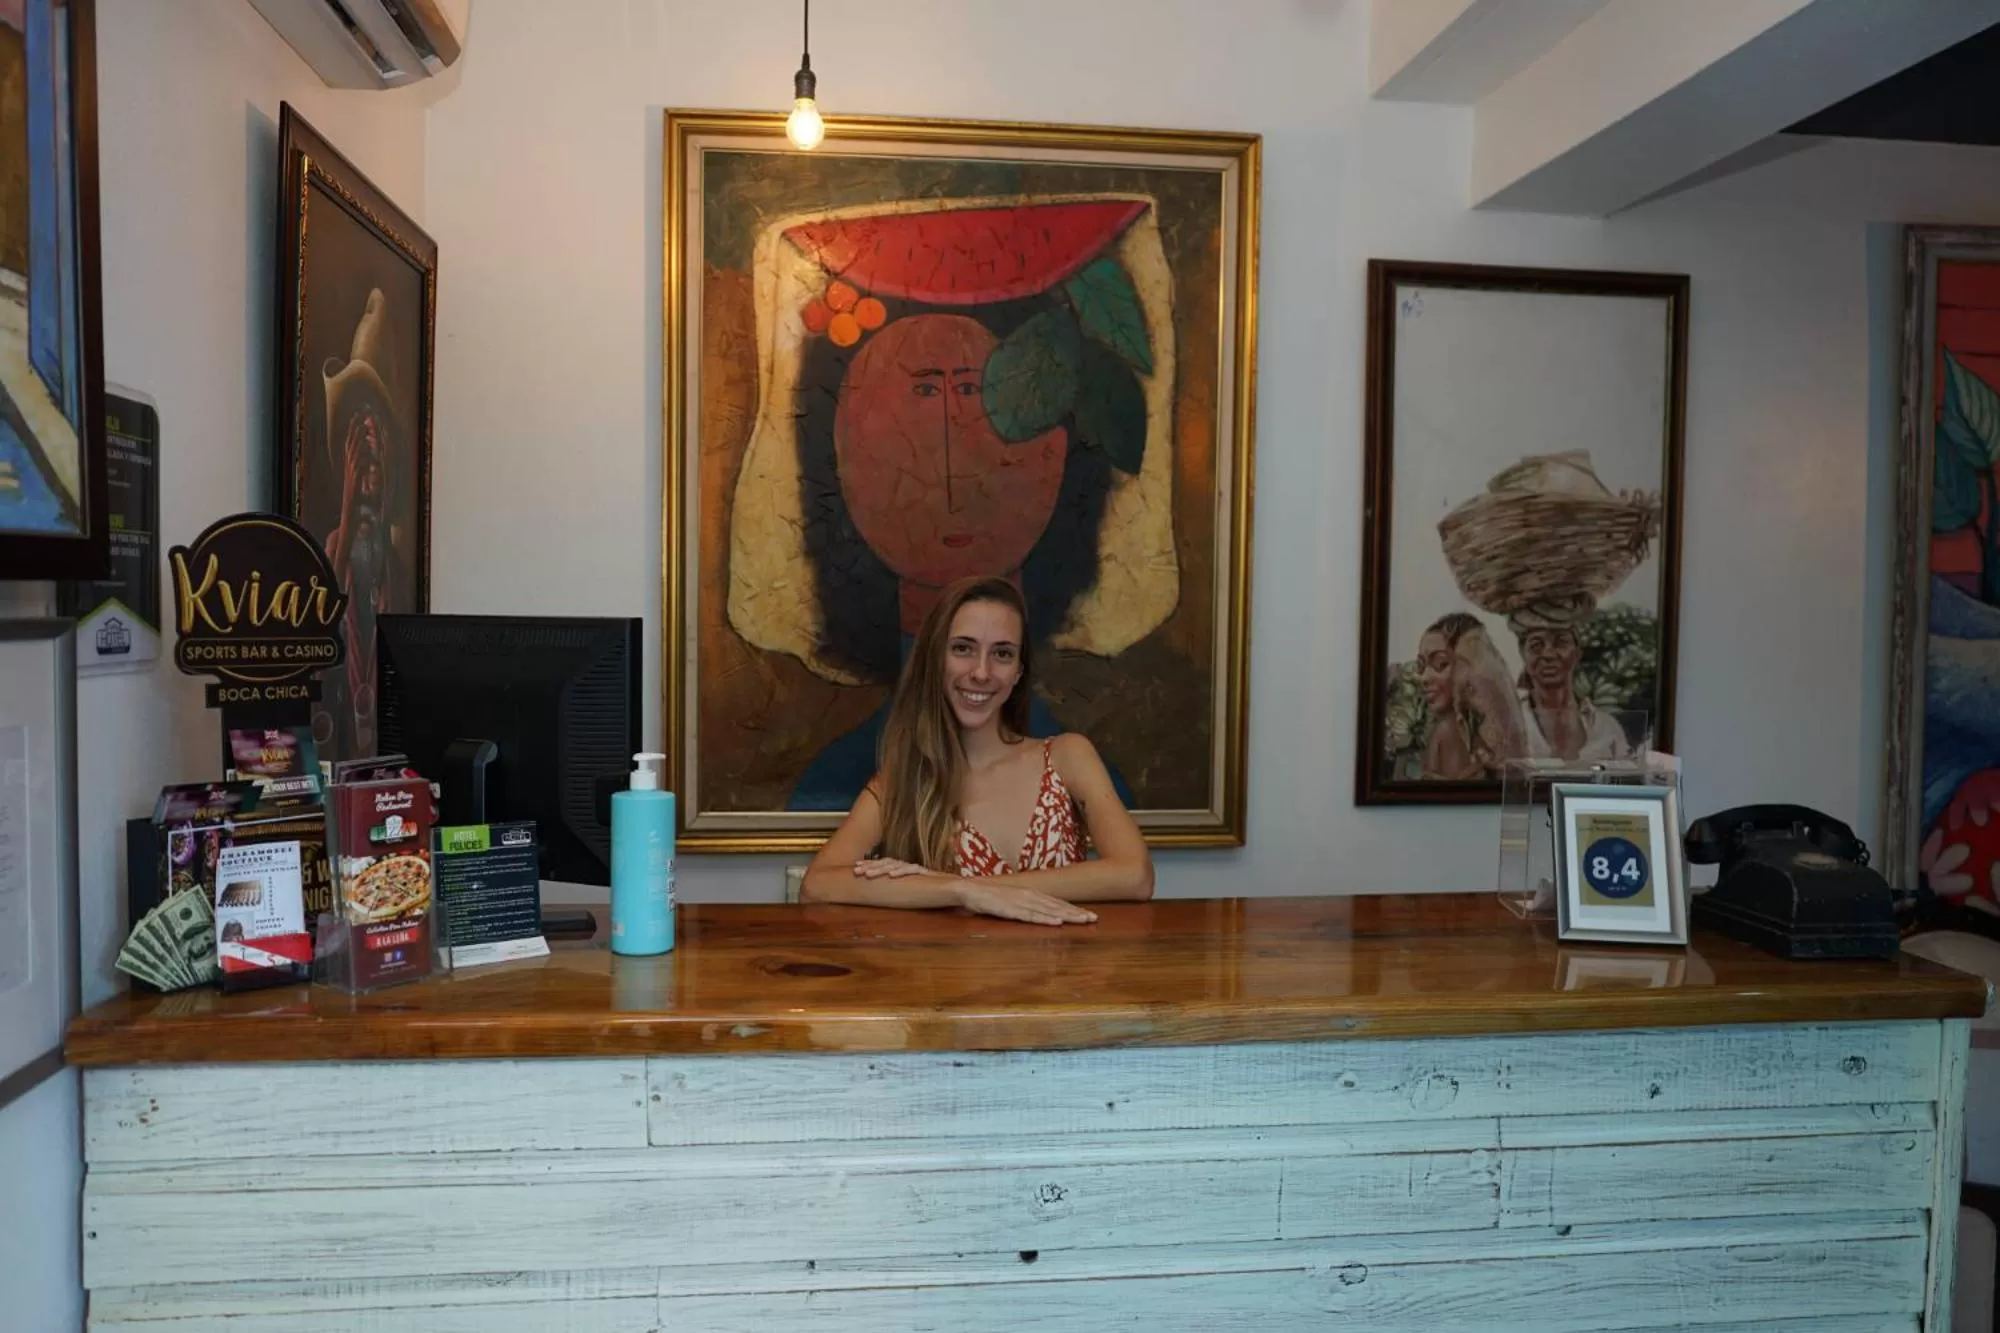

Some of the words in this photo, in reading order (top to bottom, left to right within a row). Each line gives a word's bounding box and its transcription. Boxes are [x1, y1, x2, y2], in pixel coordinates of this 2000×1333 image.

[174, 551, 341, 633] Kviar
[186, 645, 237, 660] SPORTS
[241, 644, 267, 659] BAR
[271, 645, 279, 658] &
[284, 644, 334, 658] CASINO
[218, 688, 261, 702] BOCA
[265, 686, 309, 700] CHICA
[1591, 855, 1641, 884] 8,4
